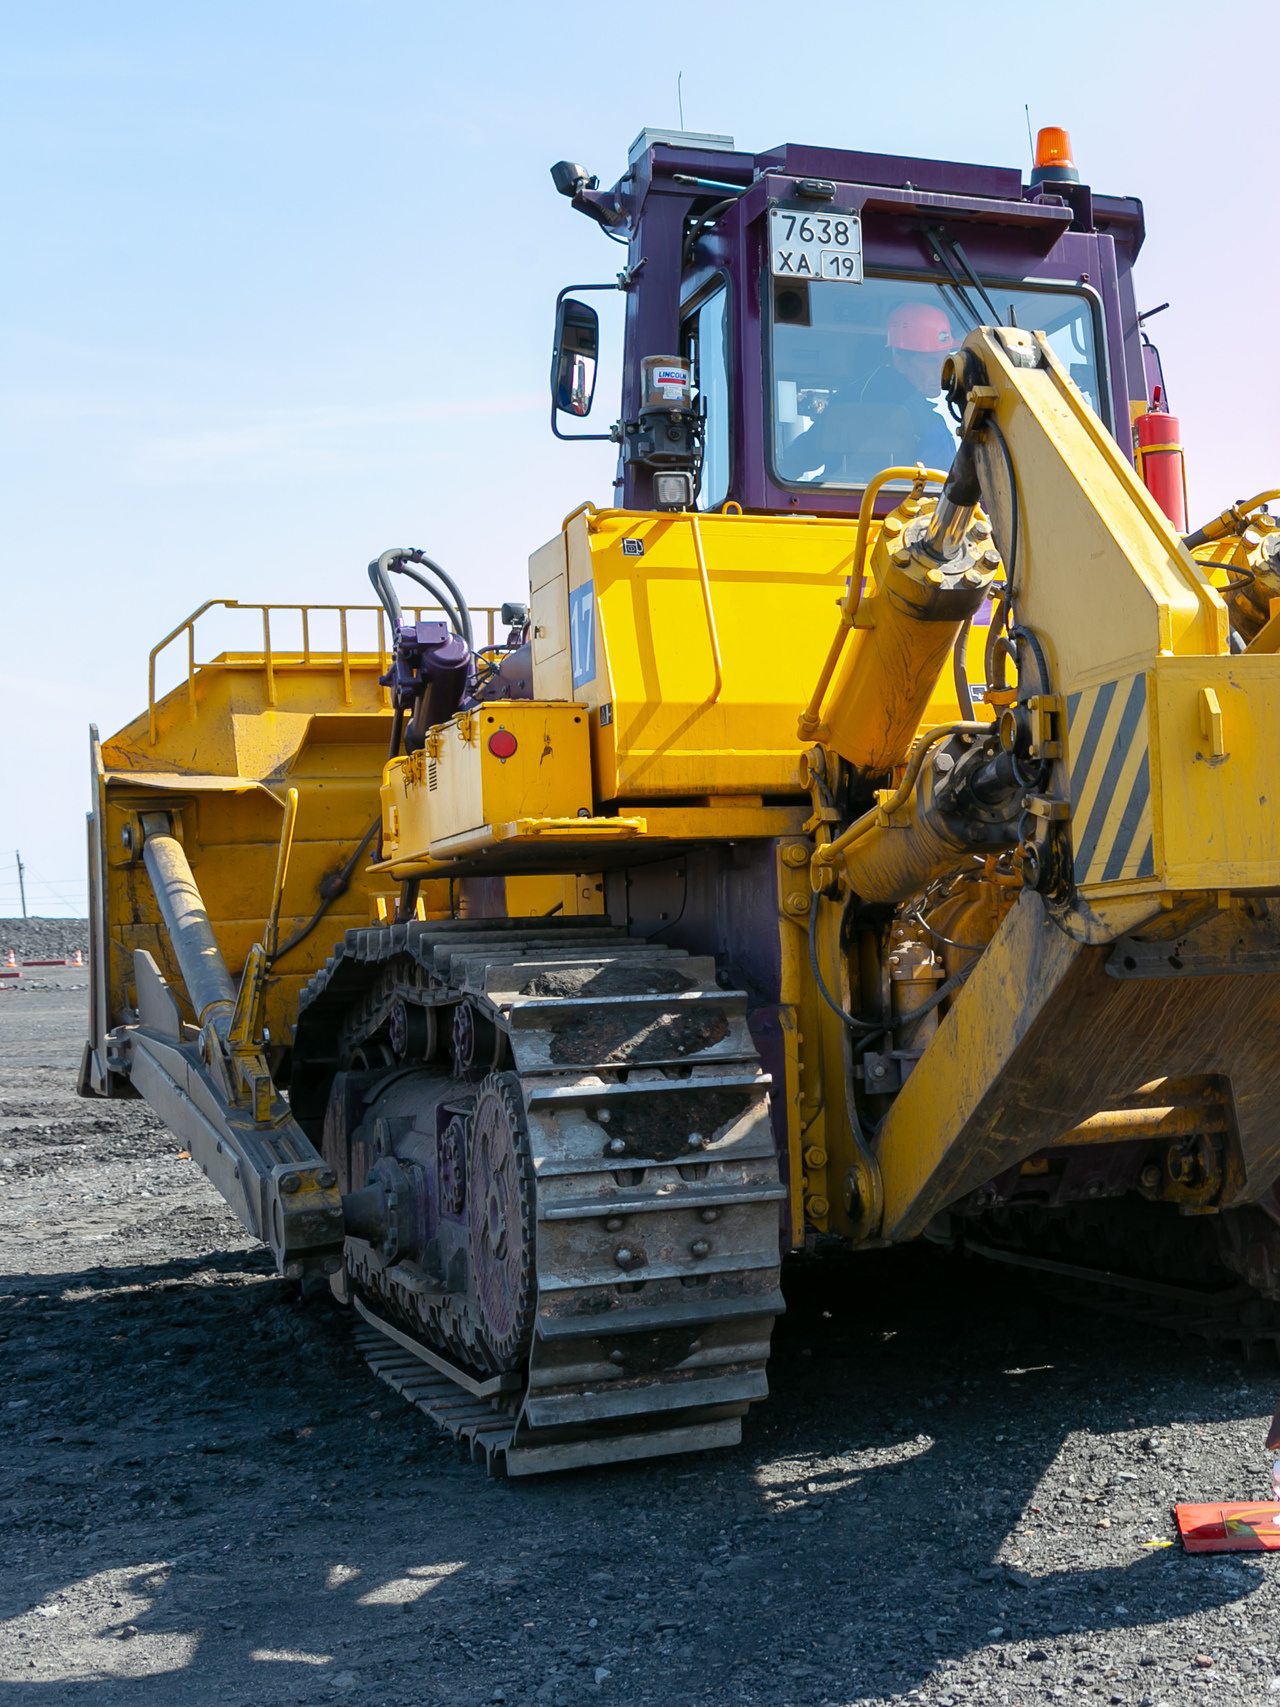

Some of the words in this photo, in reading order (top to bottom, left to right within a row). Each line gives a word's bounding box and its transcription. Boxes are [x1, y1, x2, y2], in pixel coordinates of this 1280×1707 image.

[781, 214, 850, 246] 7638
[829, 256, 855, 277] 19
[658, 371, 687, 379] LINCOLN
[570, 591, 594, 678] 17
